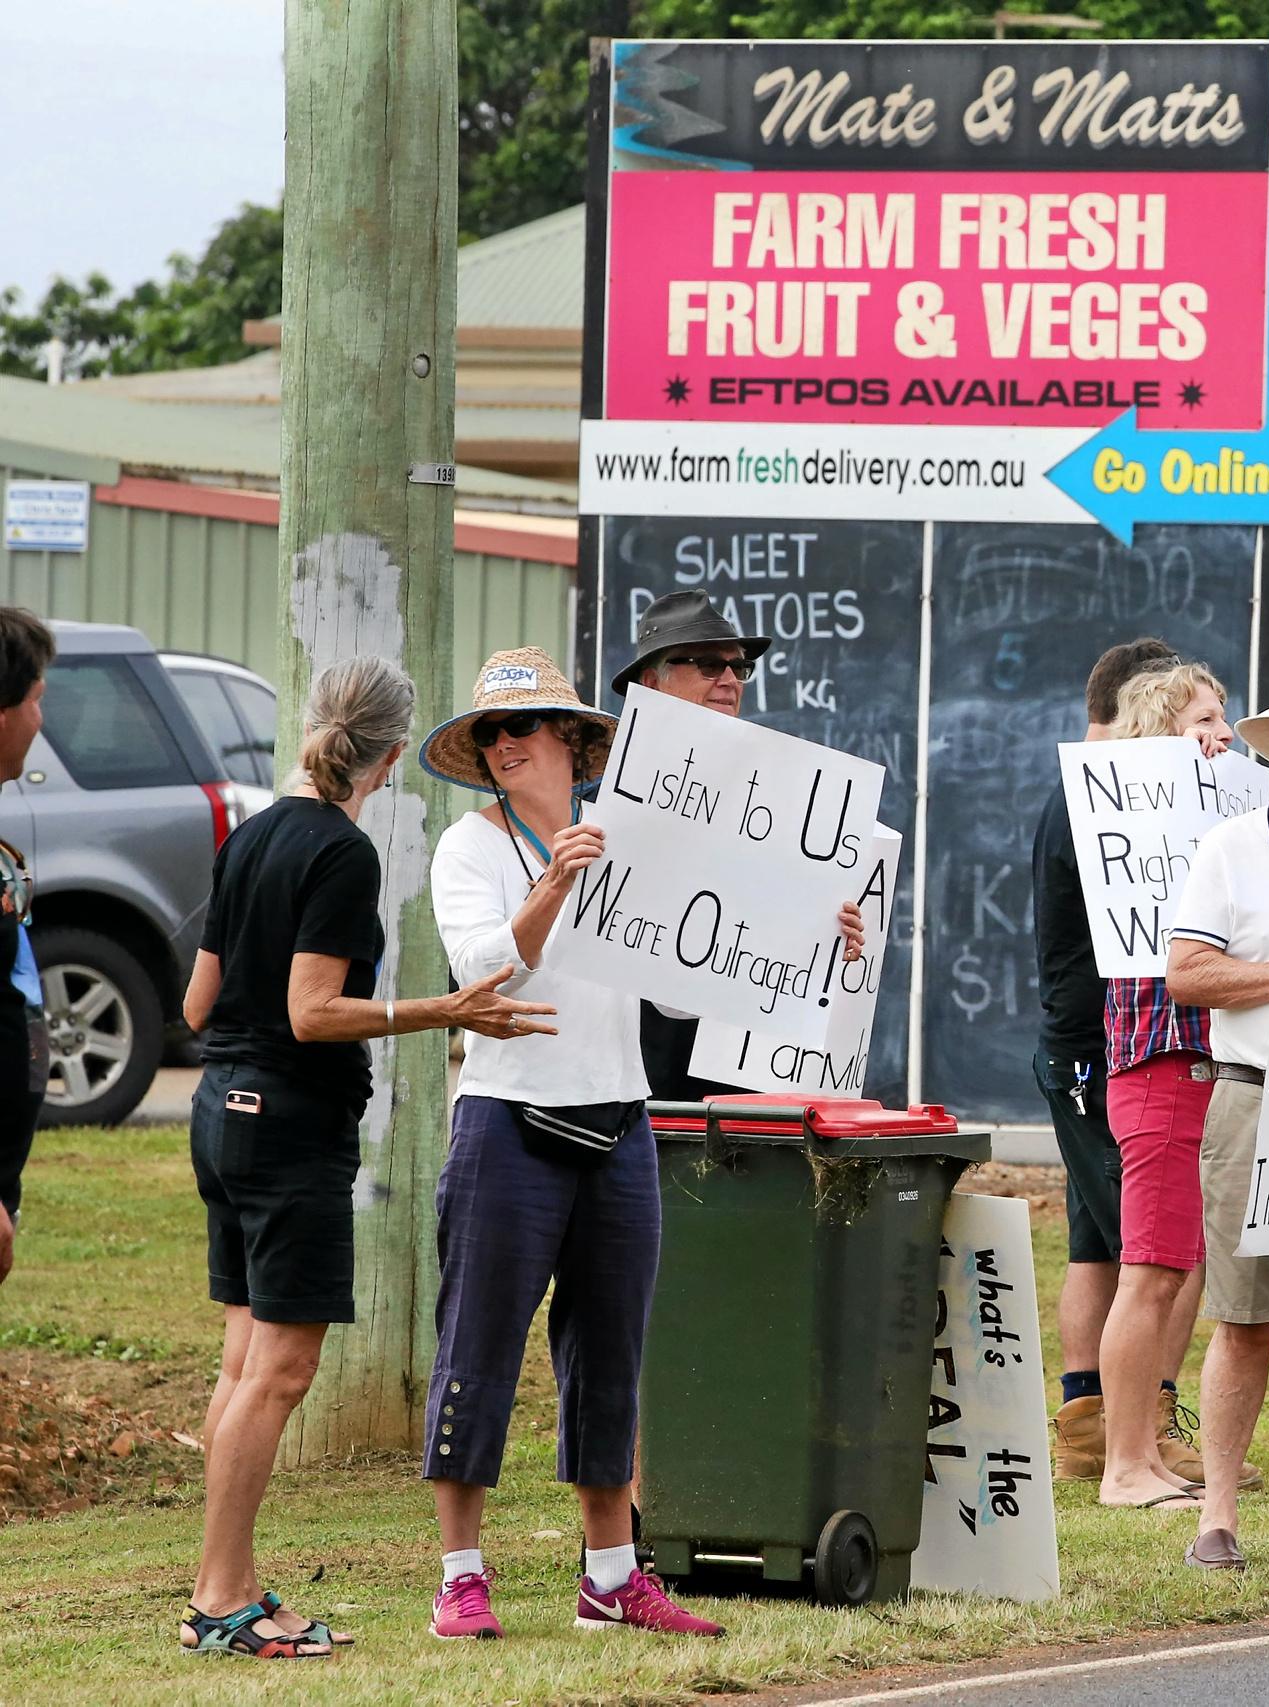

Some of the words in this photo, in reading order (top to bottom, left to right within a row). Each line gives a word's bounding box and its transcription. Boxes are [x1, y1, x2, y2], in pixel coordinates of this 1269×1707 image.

[754, 66, 937, 146] Mate
[963, 65, 1017, 145] &
[1032, 66, 1245, 146] Matts
[712, 192, 915, 268] FARM
[939, 193, 1166, 270] FRESH
[667, 281, 870, 357] FRUIT
[894, 281, 957, 358] &
[981, 282, 1208, 360] VEGES
[709, 377, 889, 406] EFTPOS
[900, 379, 1160, 408] AVAILABLE
[1093, 447, 1147, 493] Go
[675, 533, 818, 585] SWEET
[1247, 1158, 1267, 1229] I
[975, 1249, 1023, 1368] what's
[987, 1449, 1032, 1517] the
